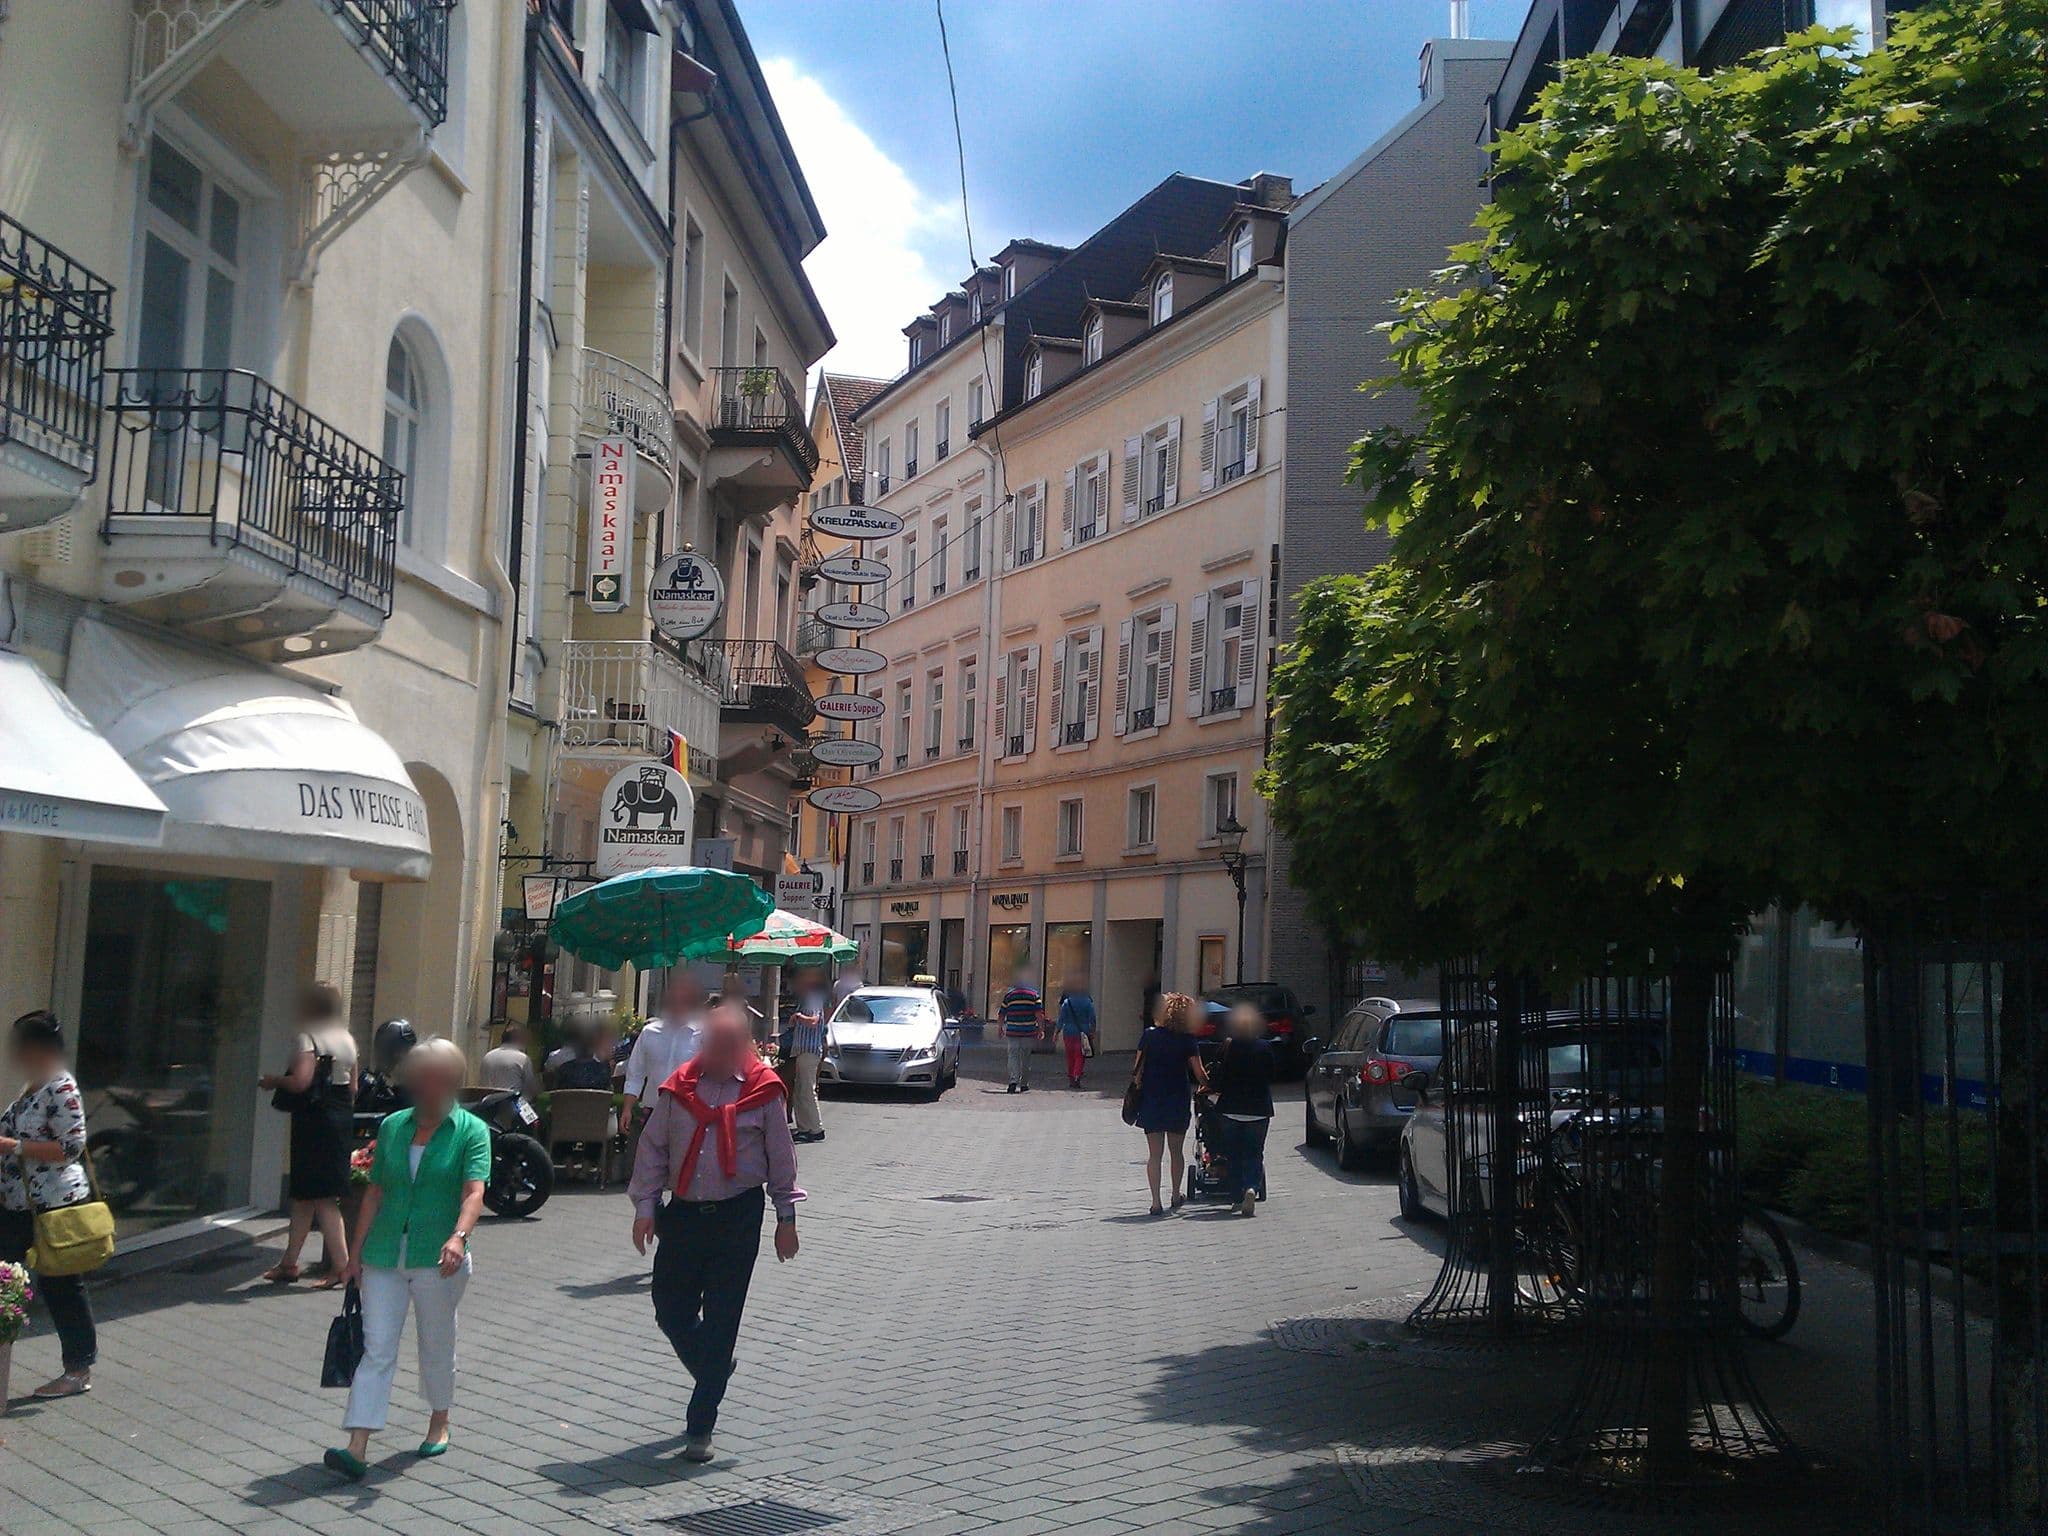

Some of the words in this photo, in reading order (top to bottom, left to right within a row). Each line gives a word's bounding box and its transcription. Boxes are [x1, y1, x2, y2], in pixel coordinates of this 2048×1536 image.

[599, 443, 624, 570] Namaskaar
[850, 509, 867, 518] DIE
[817, 516, 898, 530] KREUZPASSAGE
[656, 590, 714, 600] Namaskaar
[819, 701, 852, 712] GALERIE
[853, 703, 879, 715] Supper
[298, 783, 343, 819] DAS
[349, 788, 404, 828] WEISSE
[19, 803, 59, 827] MORE
[607, 829, 683, 844] Namaskaar
[779, 880, 811, 890] GALERIE
[782, 892, 806, 903] Supper
